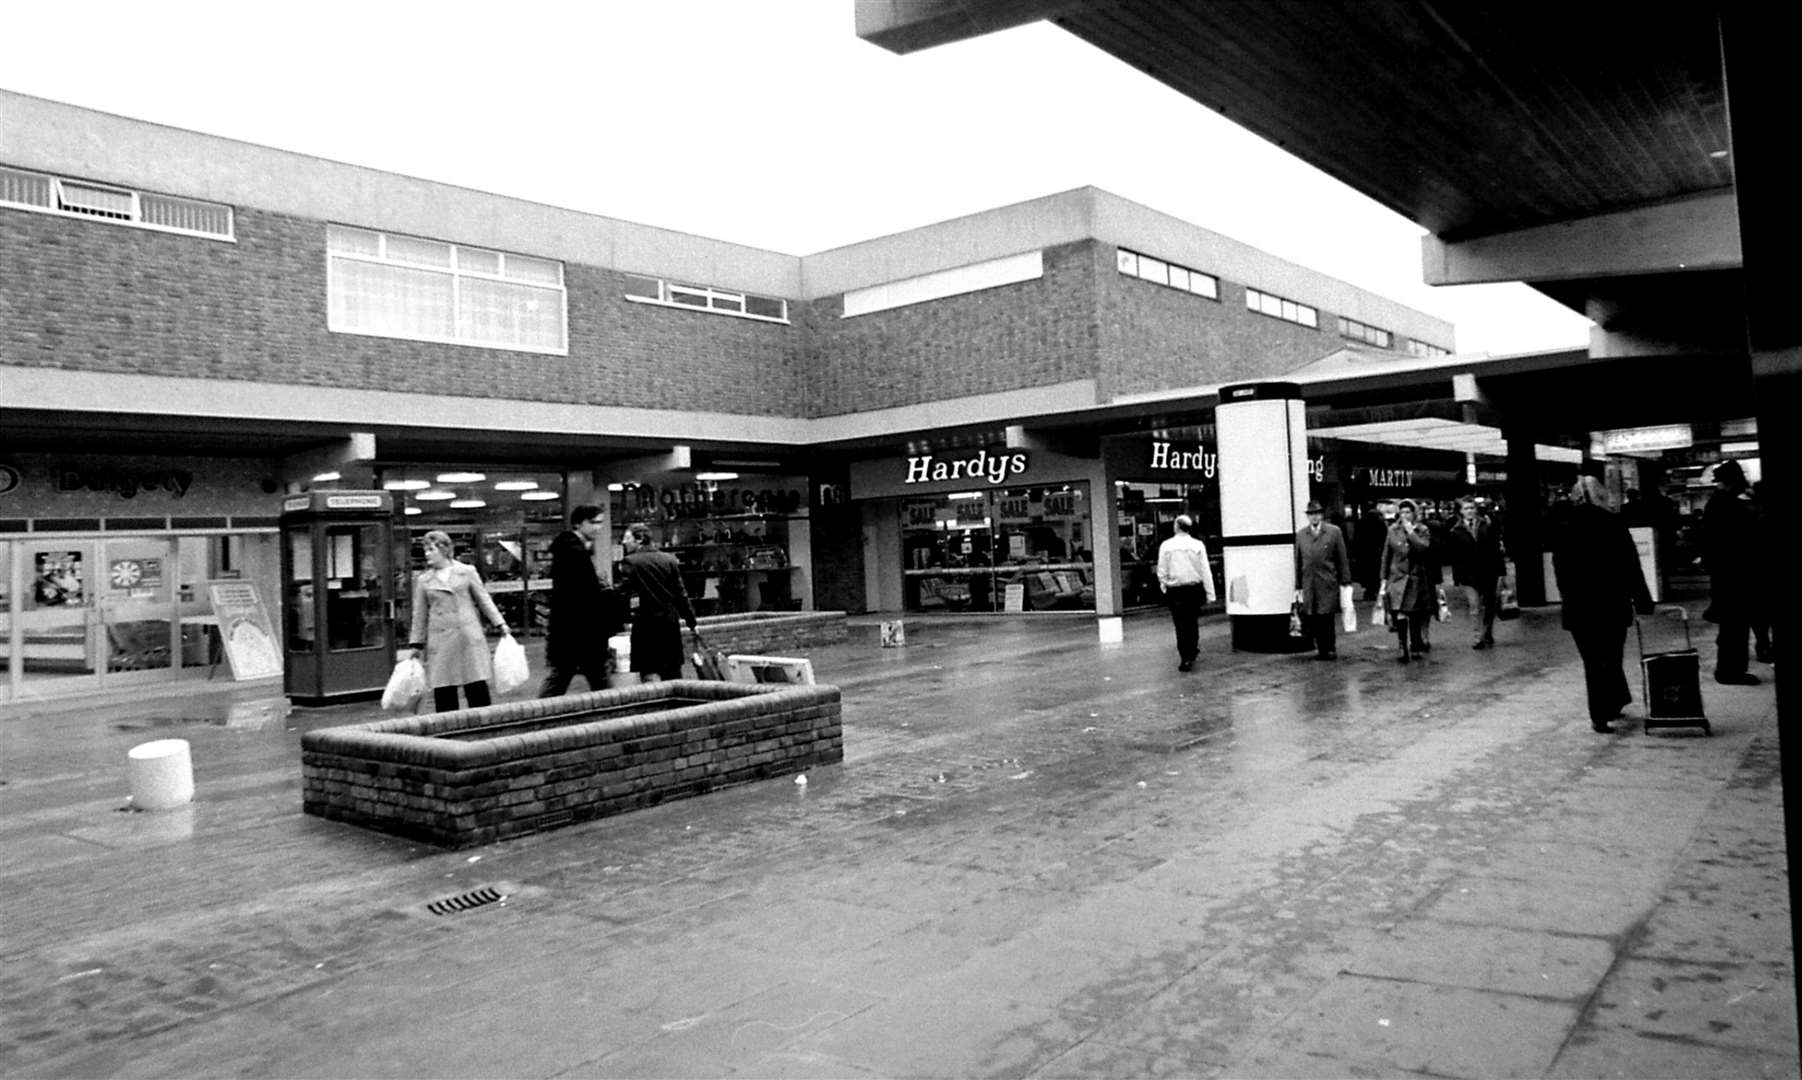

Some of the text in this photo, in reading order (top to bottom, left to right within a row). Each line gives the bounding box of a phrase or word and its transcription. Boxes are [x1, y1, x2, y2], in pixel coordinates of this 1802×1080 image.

[905, 450, 1026, 483] Hardys
[1150, 442, 1219, 478] Hardy
[1369, 468, 1413, 487] MARTIN
[909, 505, 936, 525] SALE
[957, 502, 984, 521] SALE
[1000, 500, 1028, 518] SALE
[1043, 496, 1075, 516] SALE
